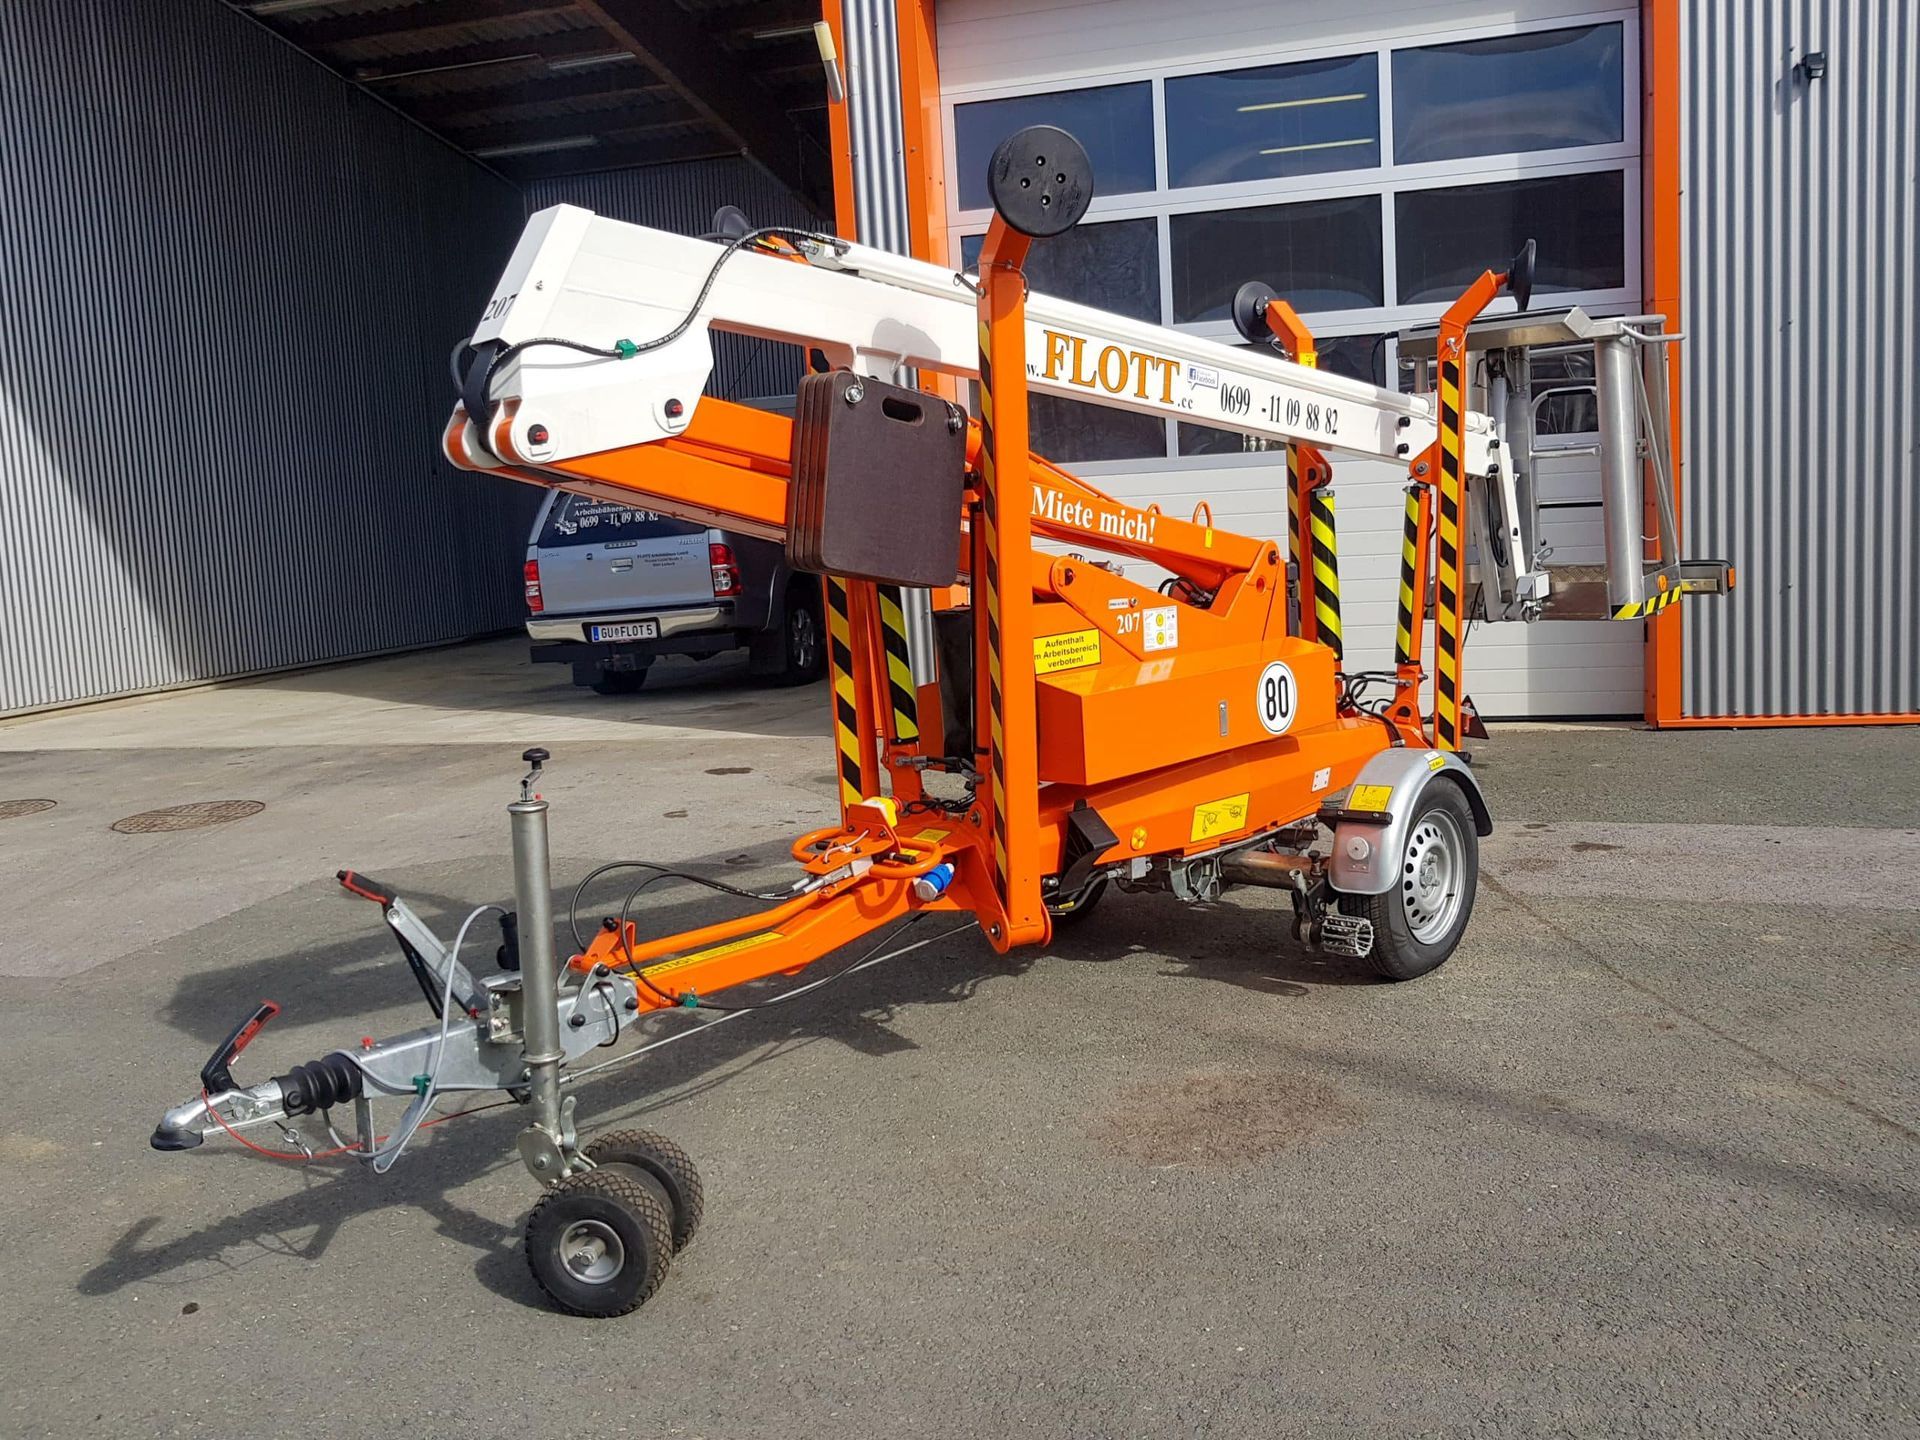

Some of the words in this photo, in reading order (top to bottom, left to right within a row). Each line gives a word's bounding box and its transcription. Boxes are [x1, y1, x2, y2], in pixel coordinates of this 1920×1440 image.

[482, 293, 519, 322] 207
[1220, 383, 1251, 416] 0699
[1286, 398, 1300, 427] 09
[1306, 402, 1320, 431] 88
[1325, 407, 1339, 435] 82
[580, 515, 599, 529] 0699
[621, 512, 632, 524] 09
[635, 511, 645, 522] 88
[1030, 485, 1093, 529] Miete
[1100, 511, 1157, 544] mich!
[601, 627, 614, 639] GU
[620, 624, 645, 638] FLOT
[647, 624, 653, 636] 5
[1116, 611, 1141, 634] 207
[1043, 643, 1098, 659] Arbeitsbereich
[1045, 635, 1085, 648] Aufenthalt
[1047, 655, 1084, 668] verboten!
[1265, 674, 1290, 722] 80
